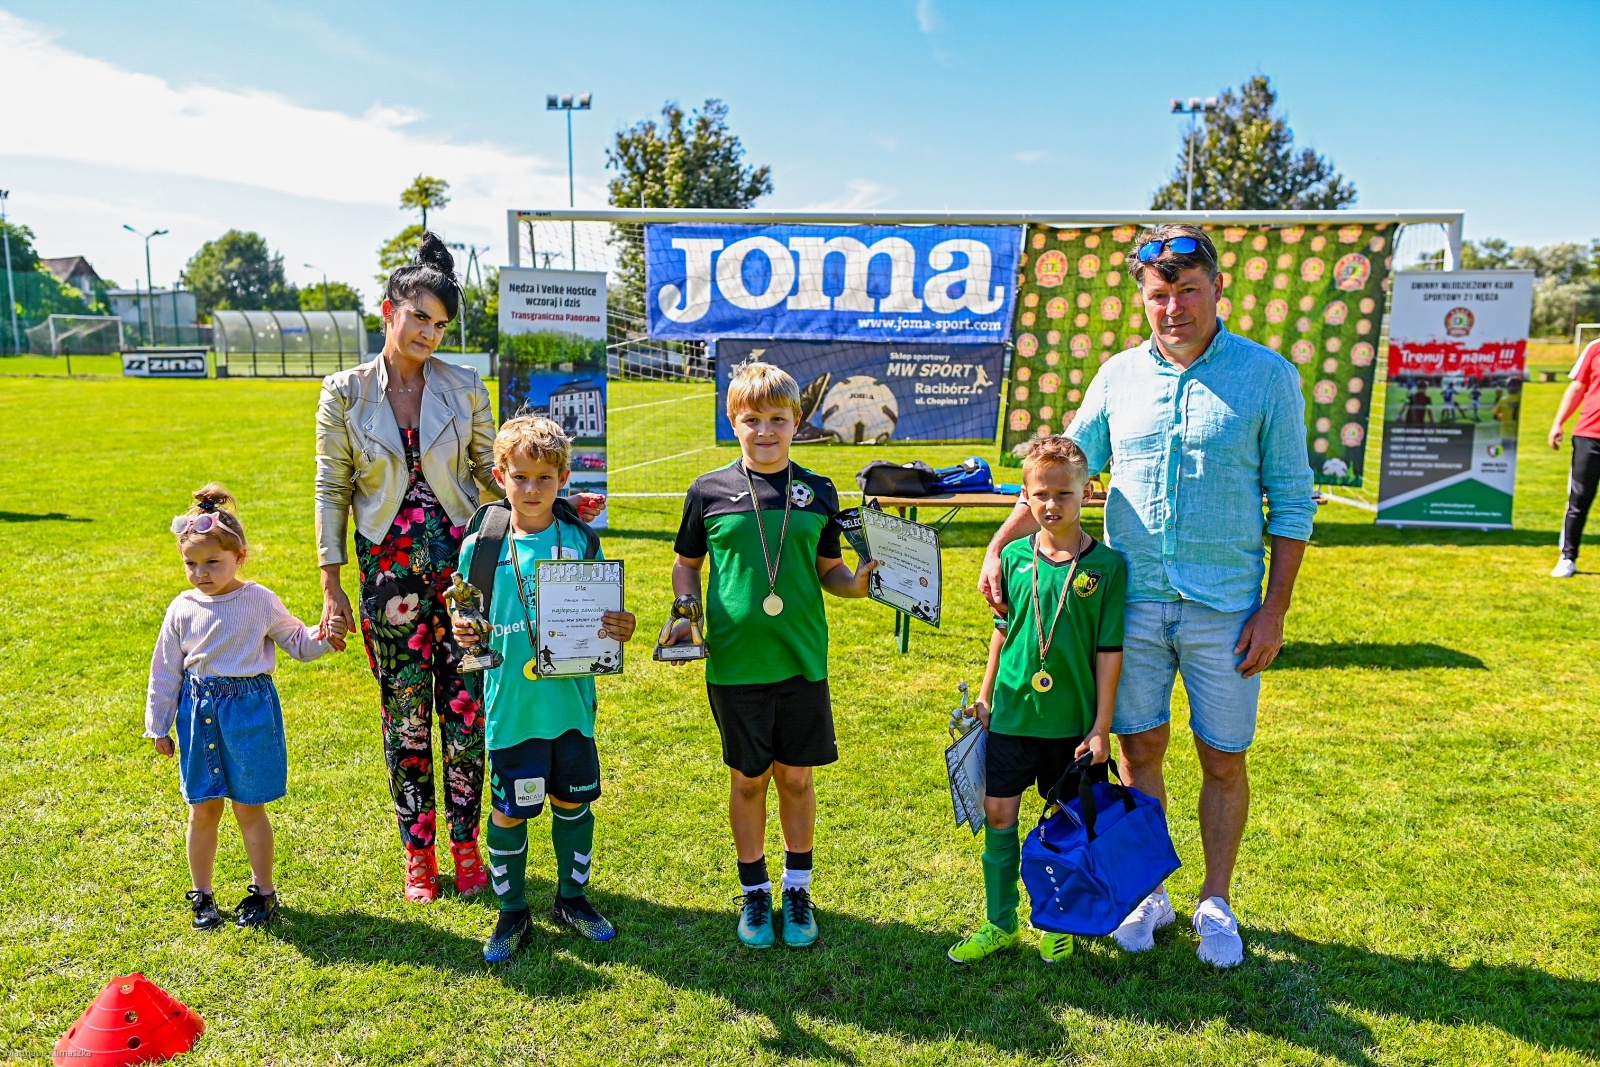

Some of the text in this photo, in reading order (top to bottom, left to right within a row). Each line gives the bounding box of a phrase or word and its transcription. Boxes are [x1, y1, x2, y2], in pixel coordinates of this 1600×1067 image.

[509, 283, 534, 294] Nędza
[536, 284, 540, 293] i
[1494, 281, 1514, 290] KLUB
[526, 297, 558, 308] wczoraj
[560, 298, 562, 306] i
[1424, 293, 1462, 301] SPORTOWY
[511, 311, 600, 322] Transgraniczna Panorama
[858, 316, 1002, 332] www.joma-sport.com
[890, 352, 950, 362] Sklep sportowy
[1400, 349, 1516, 368] Trenuj z nami !!!
[886, 363, 974, 378] MW SPORT
[915, 382, 970, 394] Racibórz
[926, 398, 958, 406] Chopina
[842, 518, 862, 528] SELEC
[540, 564, 620, 582] DYPLOM
[492, 620, 526, 637] Duet
[570, 780, 598, 792] hummel
